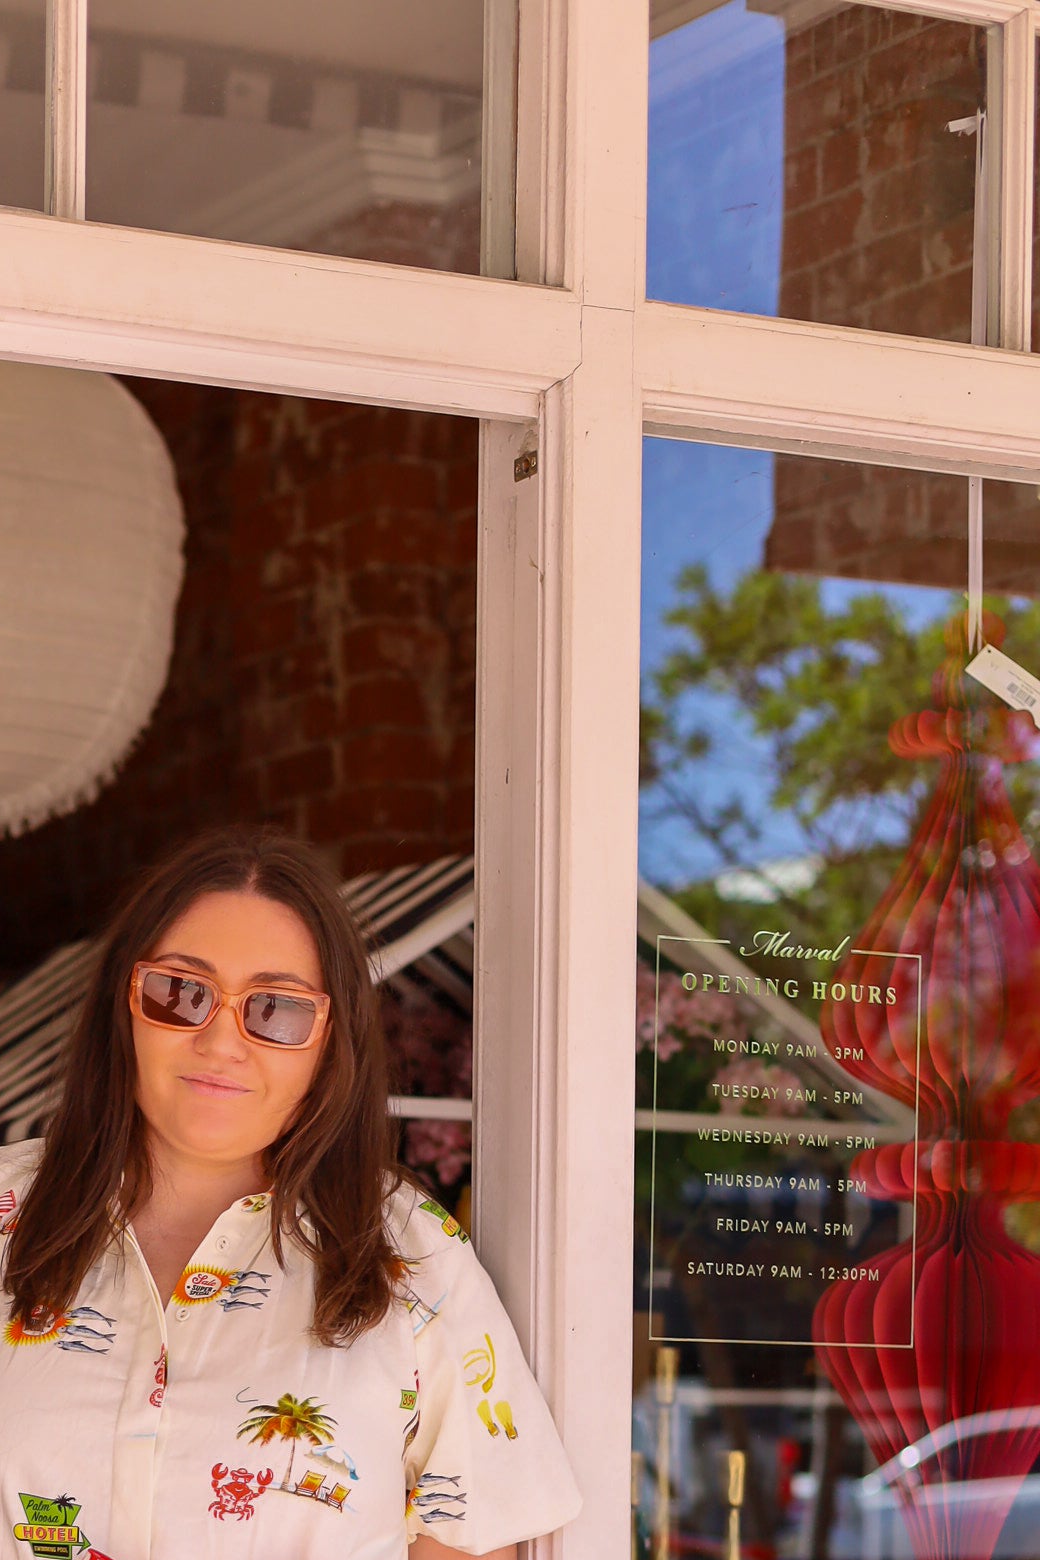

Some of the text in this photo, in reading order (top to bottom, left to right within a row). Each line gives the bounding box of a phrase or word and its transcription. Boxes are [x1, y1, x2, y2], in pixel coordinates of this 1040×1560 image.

[739, 930, 851, 963] Marval
[681, 972, 897, 1005] OPENING HOURS
[713, 1039, 780, 1056] MONDAY
[786, 1044, 817, 1058] 9AM
[835, 1047, 864, 1061] 3PM
[712, 1084, 779, 1100] TUESDAY
[786, 1088, 816, 1102] 9AM
[834, 1091, 863, 1105] 5PM
[697, 1128, 791, 1145] WEDNESDAY
[798, 1134, 829, 1147] 9AM
[846, 1136, 875, 1149] 5PM
[704, 1173, 783, 1189] THURSDAY
[789, 1177, 820, 1191] 9AM
[837, 1179, 867, 1193] 5PM
[716, 1218, 770, 1233] FRIDAY
[775, 1221, 807, 1235] 9AM
[824, 1223, 853, 1236] 5PM
[192, 1274, 217, 1286] Sale
[687, 1262, 765, 1277] SATURDAY
[770, 1265, 802, 1278] 9AM
[820, 1268, 880, 1282] 12:30PM
[192, 1285, 213, 1293] SUPER
[26, 1499, 51, 1511] Palm
[32, 1512, 59, 1523] Noosa
[23, 1526, 76, 1541] HOTEL
